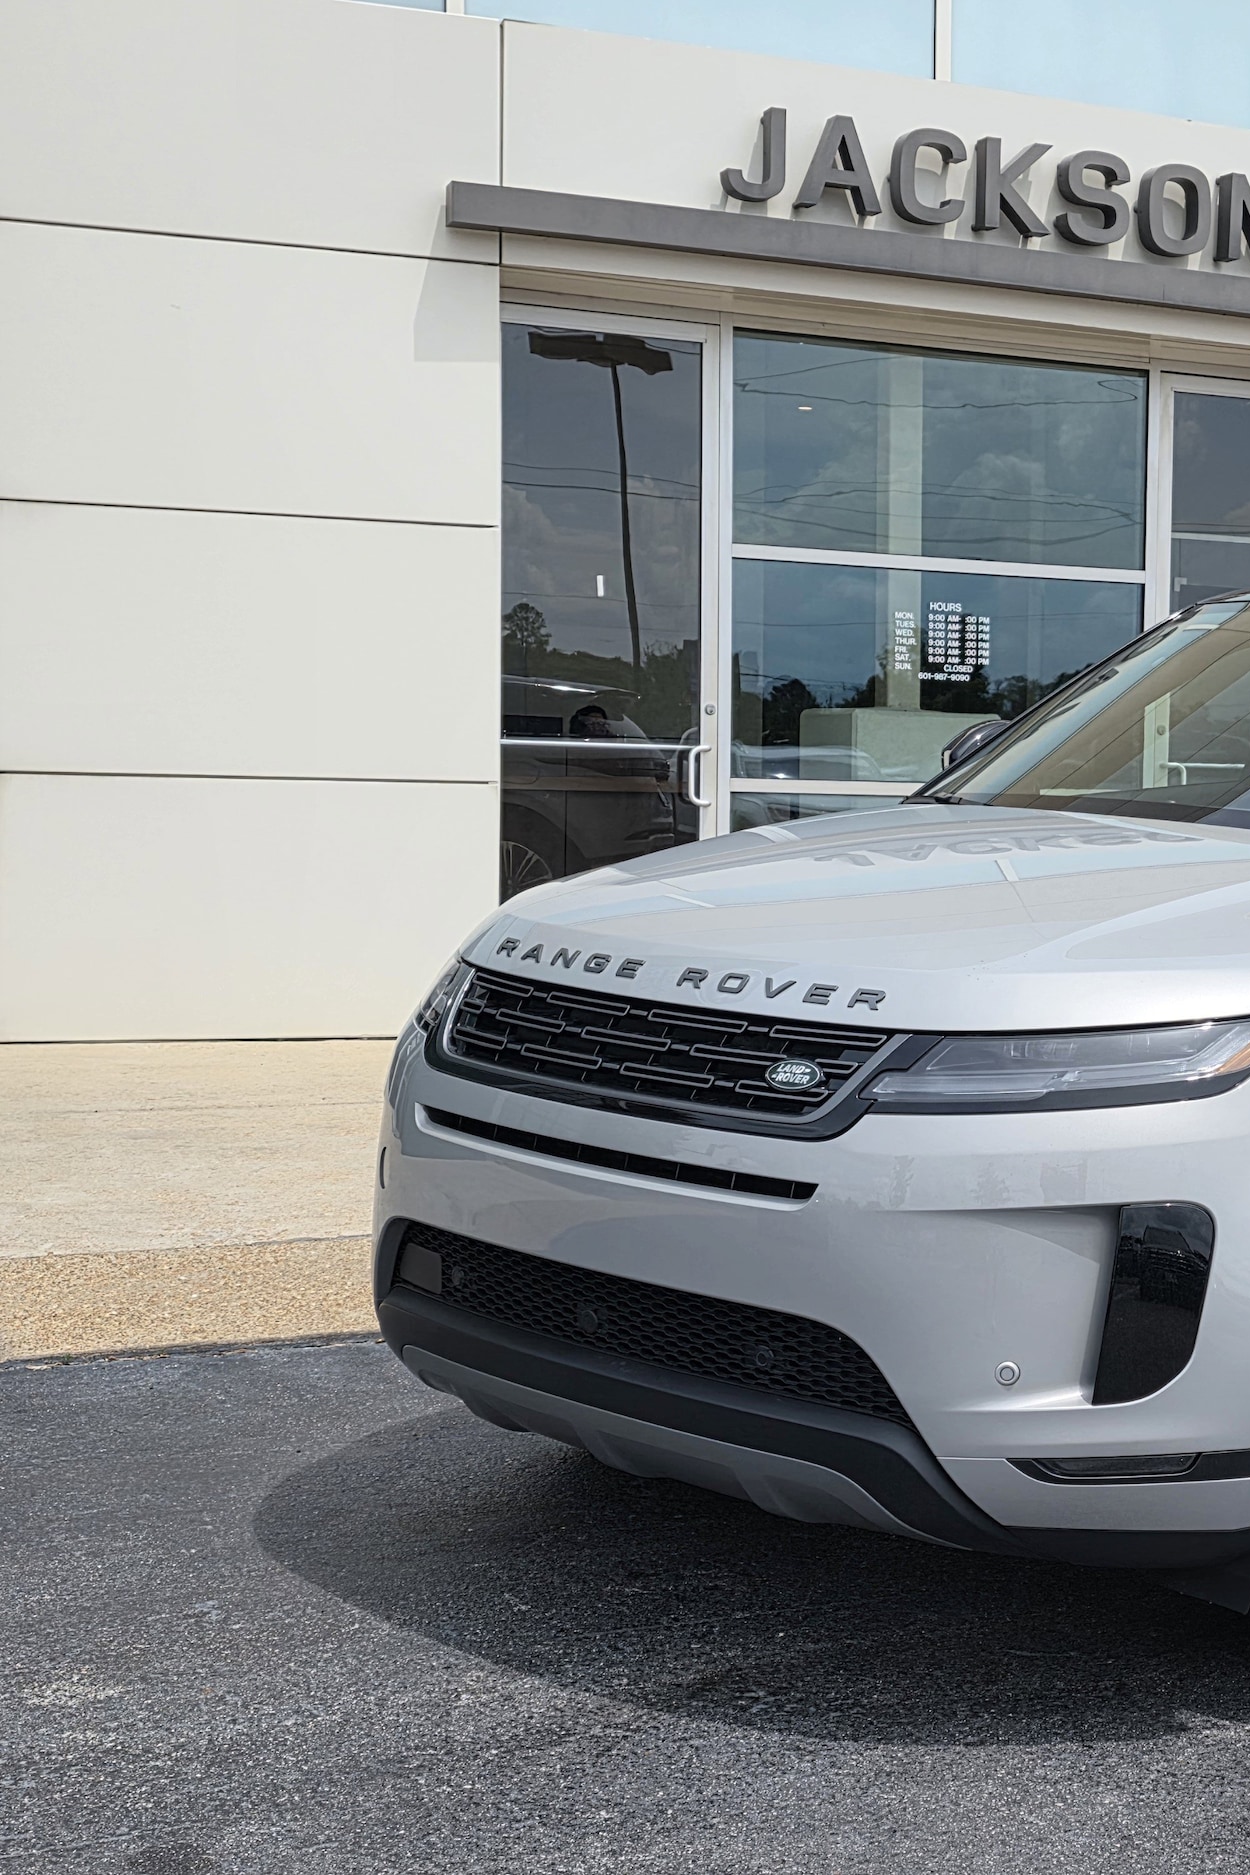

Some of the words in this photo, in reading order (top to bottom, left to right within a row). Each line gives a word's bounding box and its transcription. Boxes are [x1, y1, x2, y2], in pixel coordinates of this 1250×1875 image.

[929, 602, 962, 612] HOURS
[928, 614, 945, 622] 9:00
[928, 622, 945, 630] 9:00
[978, 625, 990, 633] PM
[895, 637, 917, 645] THUR.
[928, 647, 945, 655] 9:00
[978, 650, 990, 658] PM
[978, 658, 990, 666] PM
[944, 665, 973, 673] CLOSED
[497, 936, 646, 979] RANGE
[676, 967, 887, 1011] ROVER
[777, 1064, 805, 1073] LAND
[776, 1072, 809, 1084] ROVER
